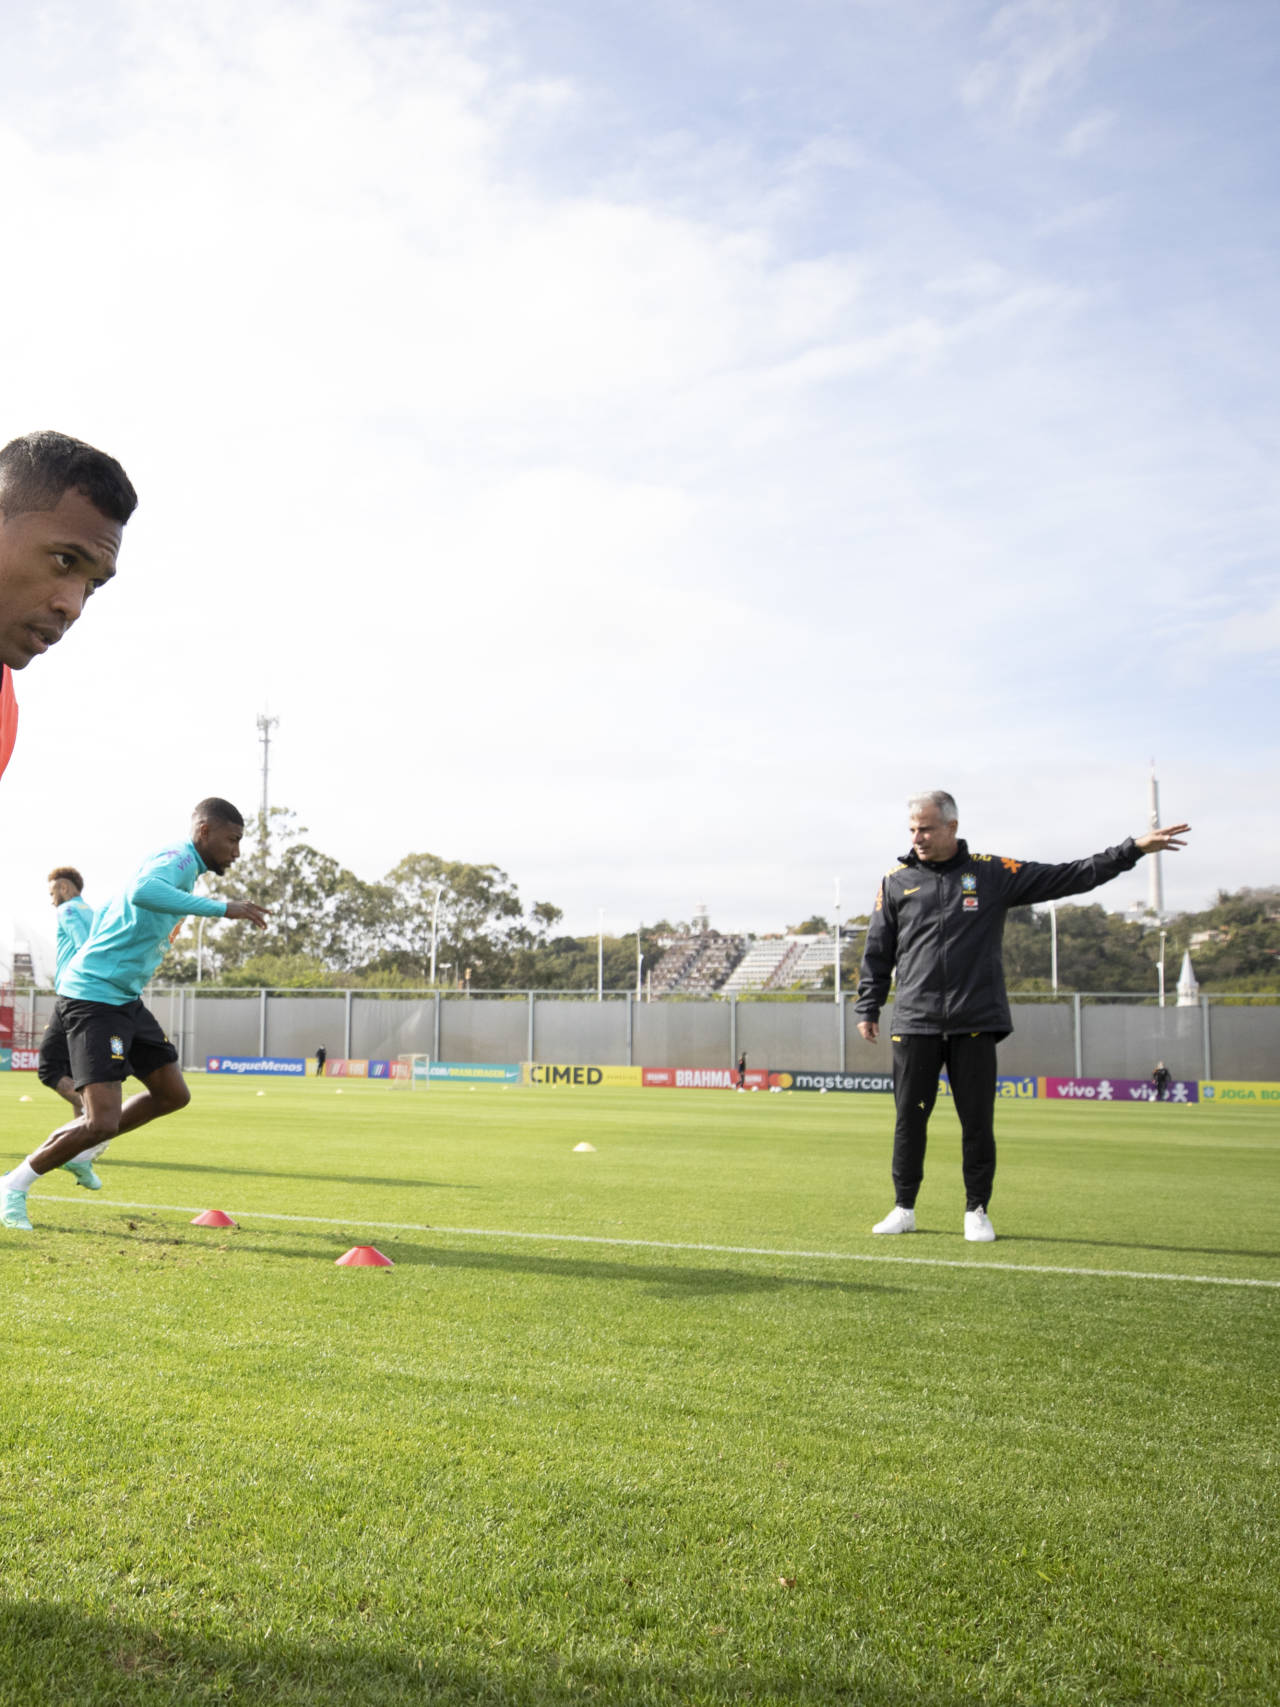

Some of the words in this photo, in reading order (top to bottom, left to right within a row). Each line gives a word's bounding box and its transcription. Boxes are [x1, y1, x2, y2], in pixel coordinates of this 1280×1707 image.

[11, 1051, 40, 1069] SEM
[222, 1060, 304, 1073] PagueMenos
[531, 1066, 603, 1085] CIMED
[796, 1073, 894, 1090] mastercar
[1057, 1082, 1096, 1098] vivo
[1219, 1088, 1257, 1100] JOGA
